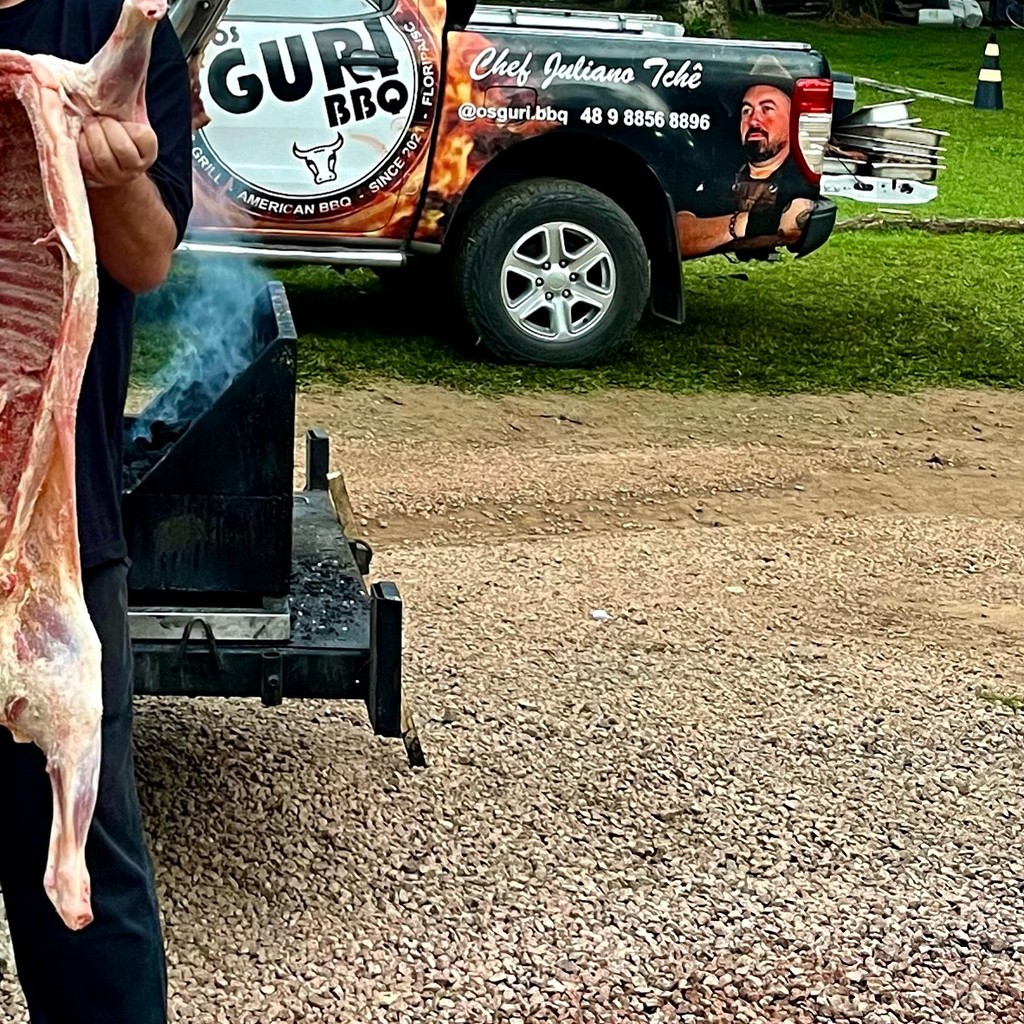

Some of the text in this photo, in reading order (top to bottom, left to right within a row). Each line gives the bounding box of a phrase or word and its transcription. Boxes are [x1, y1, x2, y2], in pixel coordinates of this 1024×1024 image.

[212, 26, 240, 46] OS
[207, 18, 399, 114] GURI
[469, 46, 704, 90] Chef Juliano Tchê
[324, 79, 409, 127] BBQ
[458, 102, 711, 131] @osguri.bbq 48 9 8856 8896
[191, 146, 222, 185] GRILL
[237, 190, 315, 215] AMERICAN
[318, 196, 352, 213] BBQ
[368, 156, 406, 193] SINCE
[401, 126, 425, 158] 2021
